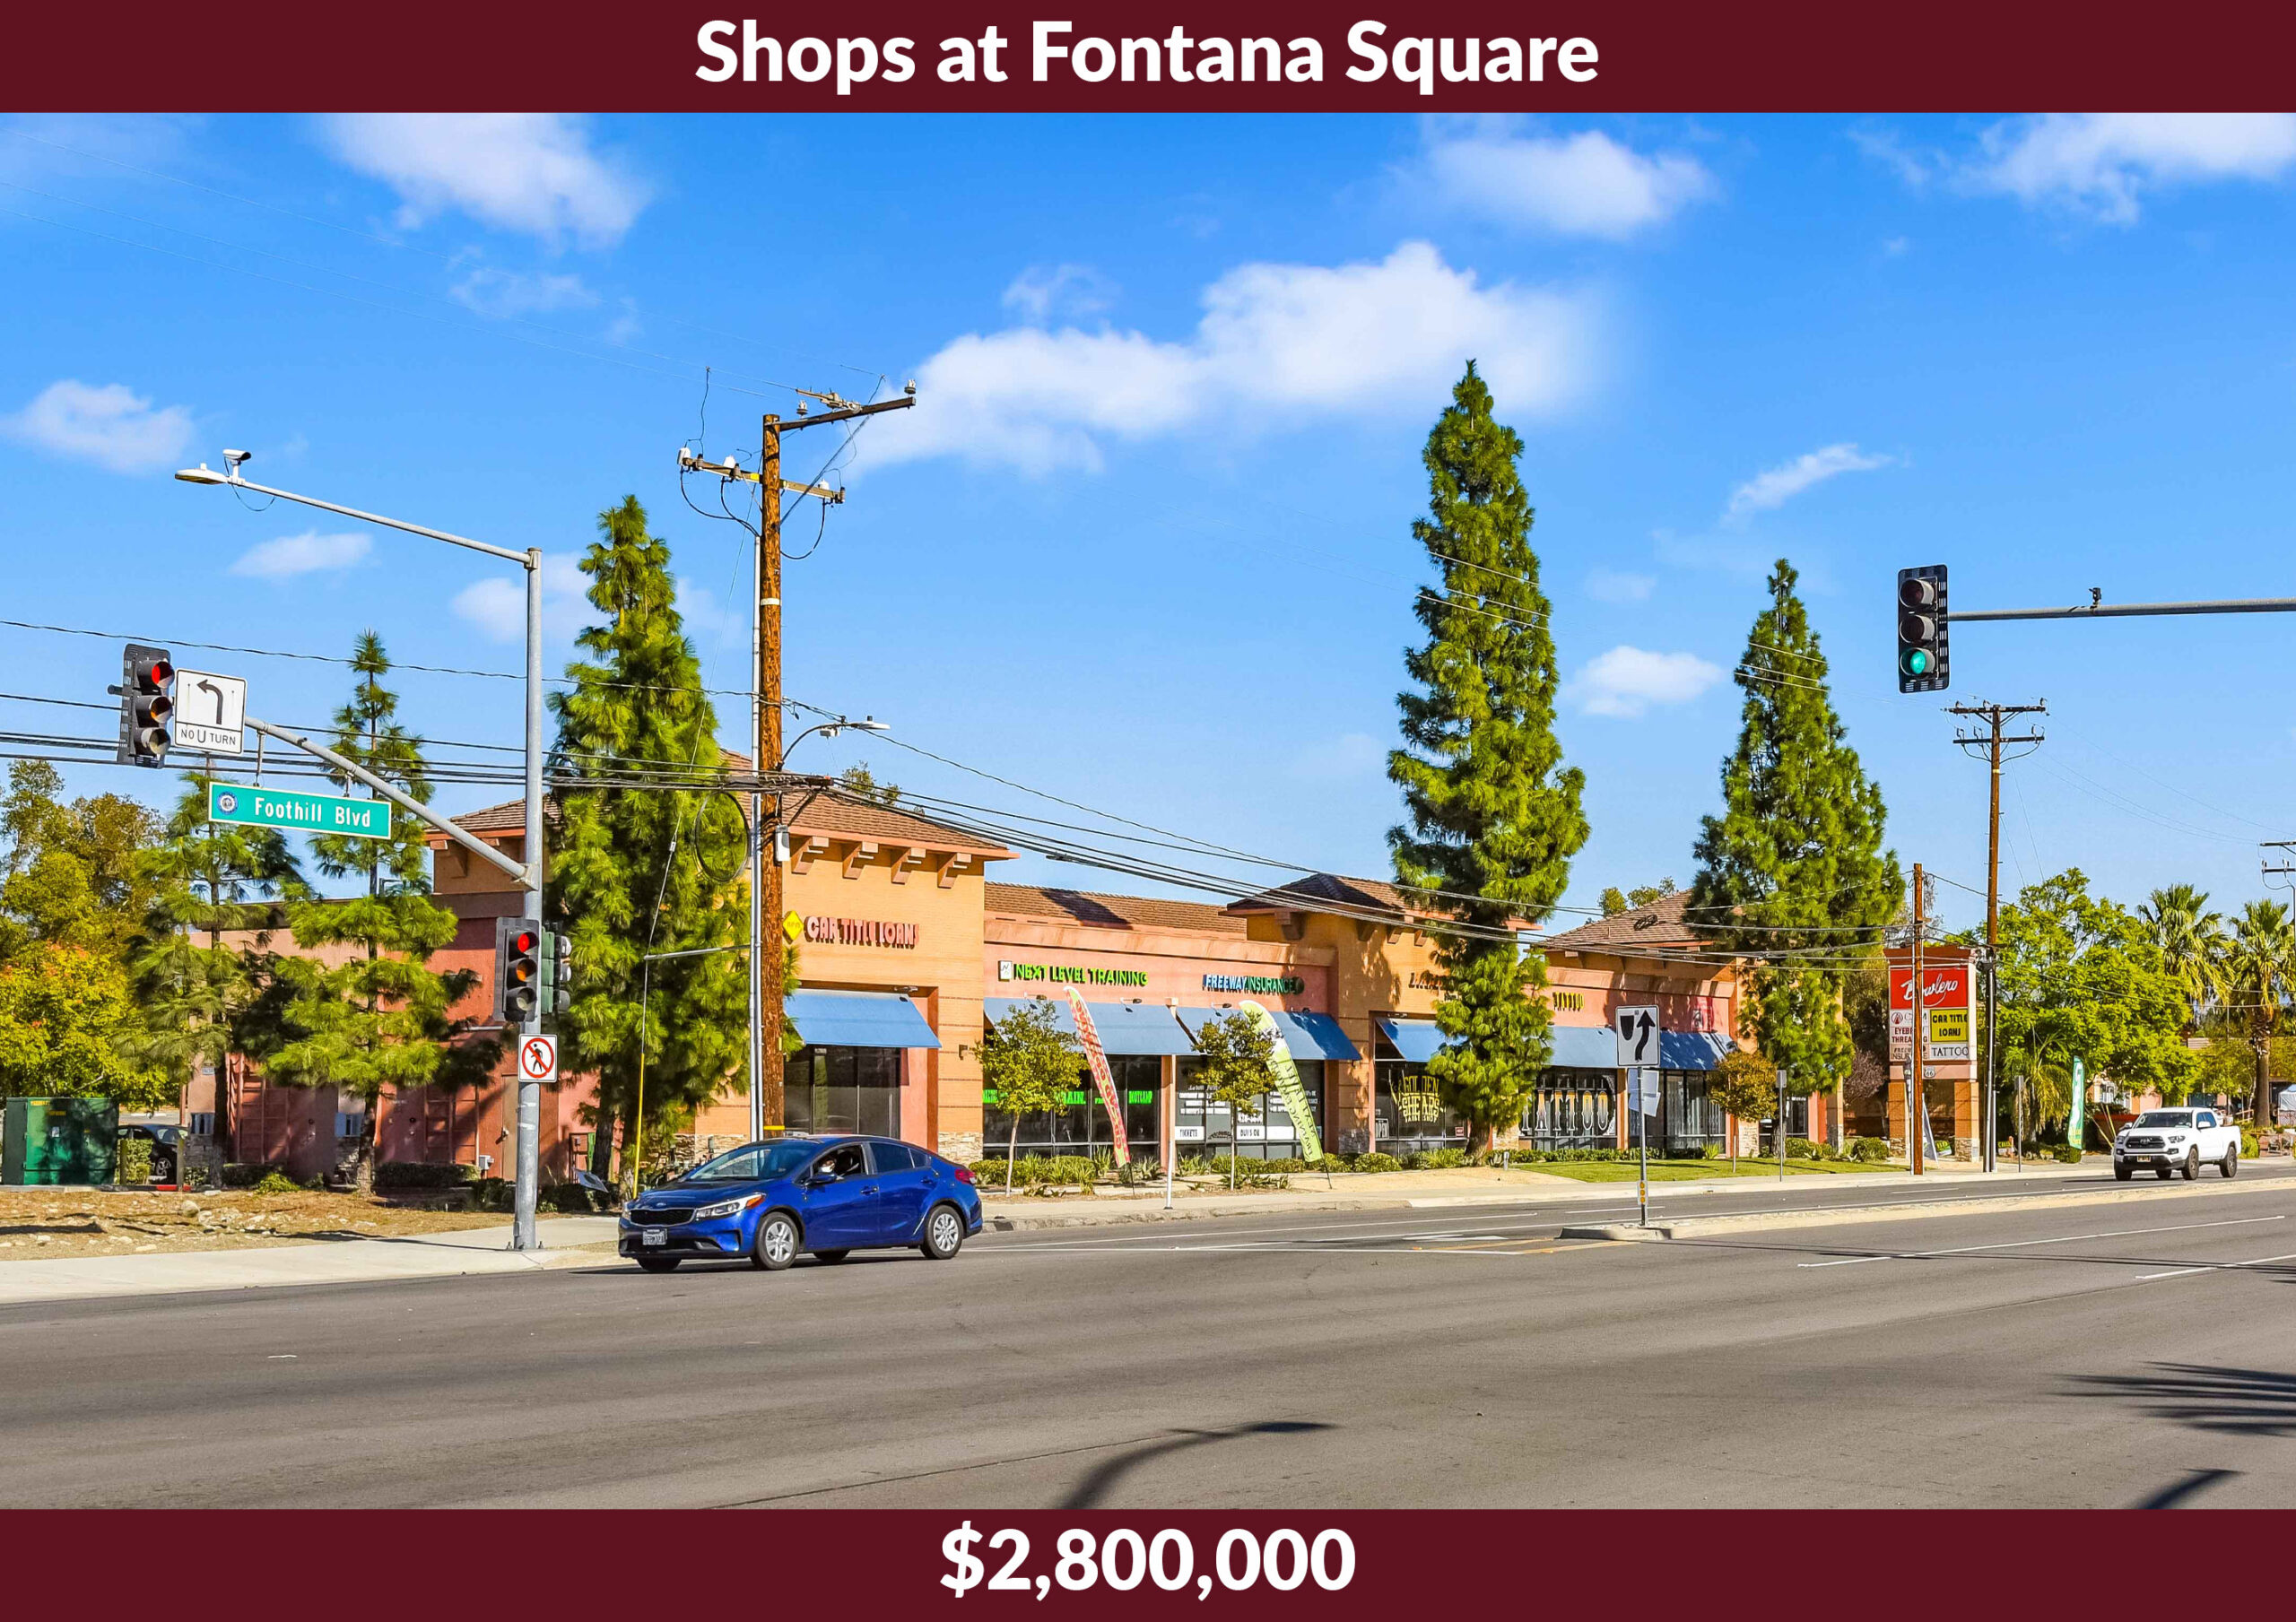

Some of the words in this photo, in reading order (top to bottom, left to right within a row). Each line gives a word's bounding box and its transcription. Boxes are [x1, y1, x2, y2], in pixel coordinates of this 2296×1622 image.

[180, 728, 195, 740] NO
[196, 729, 206, 743] U
[209, 733, 236, 746] TURN
[255, 796, 322, 822] Foothill
[335, 806, 371, 828] Blvd
[805, 915, 839, 941] CAR
[879, 921, 919, 946] LOANS
[1014, 964, 1048, 980] NEXT
[1051, 966, 1087, 983] LEVEL
[1089, 967, 1148, 986] TRAINING
[1204, 975, 1247, 991] FREEWAY
[1247, 976, 1296, 994] INSURANCE
[1900, 973, 1958, 1006] Bwlero
[1932, 1014, 1948, 1024] CAR
[1950, 1014, 1968, 1023] TITLE
[1892, 1036, 1928, 1044] THREAG
[1894, 1027, 1926, 1035] EYEB
[1939, 1028, 1961, 1037] LOANS
[1931, 1046, 1969, 1057] TATTOO
[1403, 1075, 1439, 1097] GOLDEN
[1401, 1095, 1440, 1118] SHEARS
[1521, 1089, 1609, 1131] TATTOO
